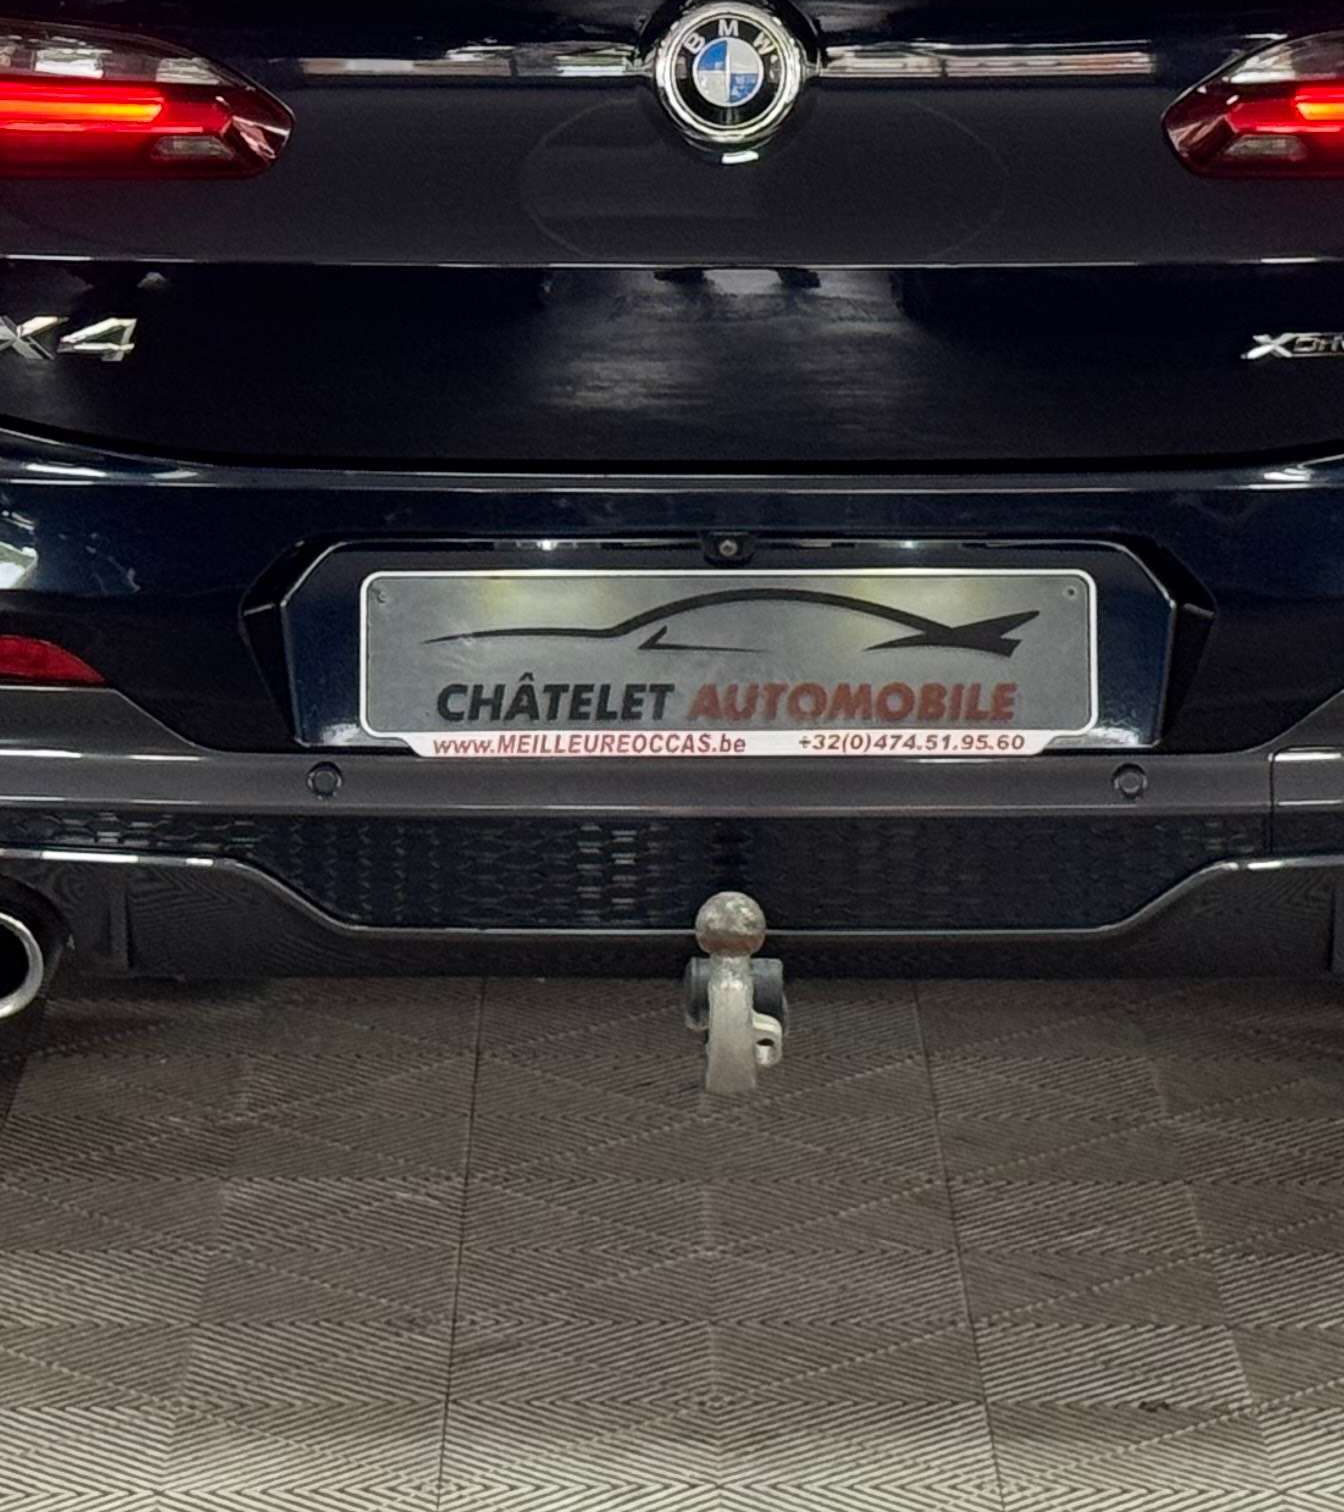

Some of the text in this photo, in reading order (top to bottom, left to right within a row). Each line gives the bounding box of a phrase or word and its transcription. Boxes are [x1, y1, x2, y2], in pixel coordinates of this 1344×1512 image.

[683, 19, 776, 55] BMW
[436, 672, 1018, 722] CHÂTELET AUTOMOBILE
[433, 733, 1026, 755] www.MEILLEUREOCCAS.be +32(0)474.51.95.60
